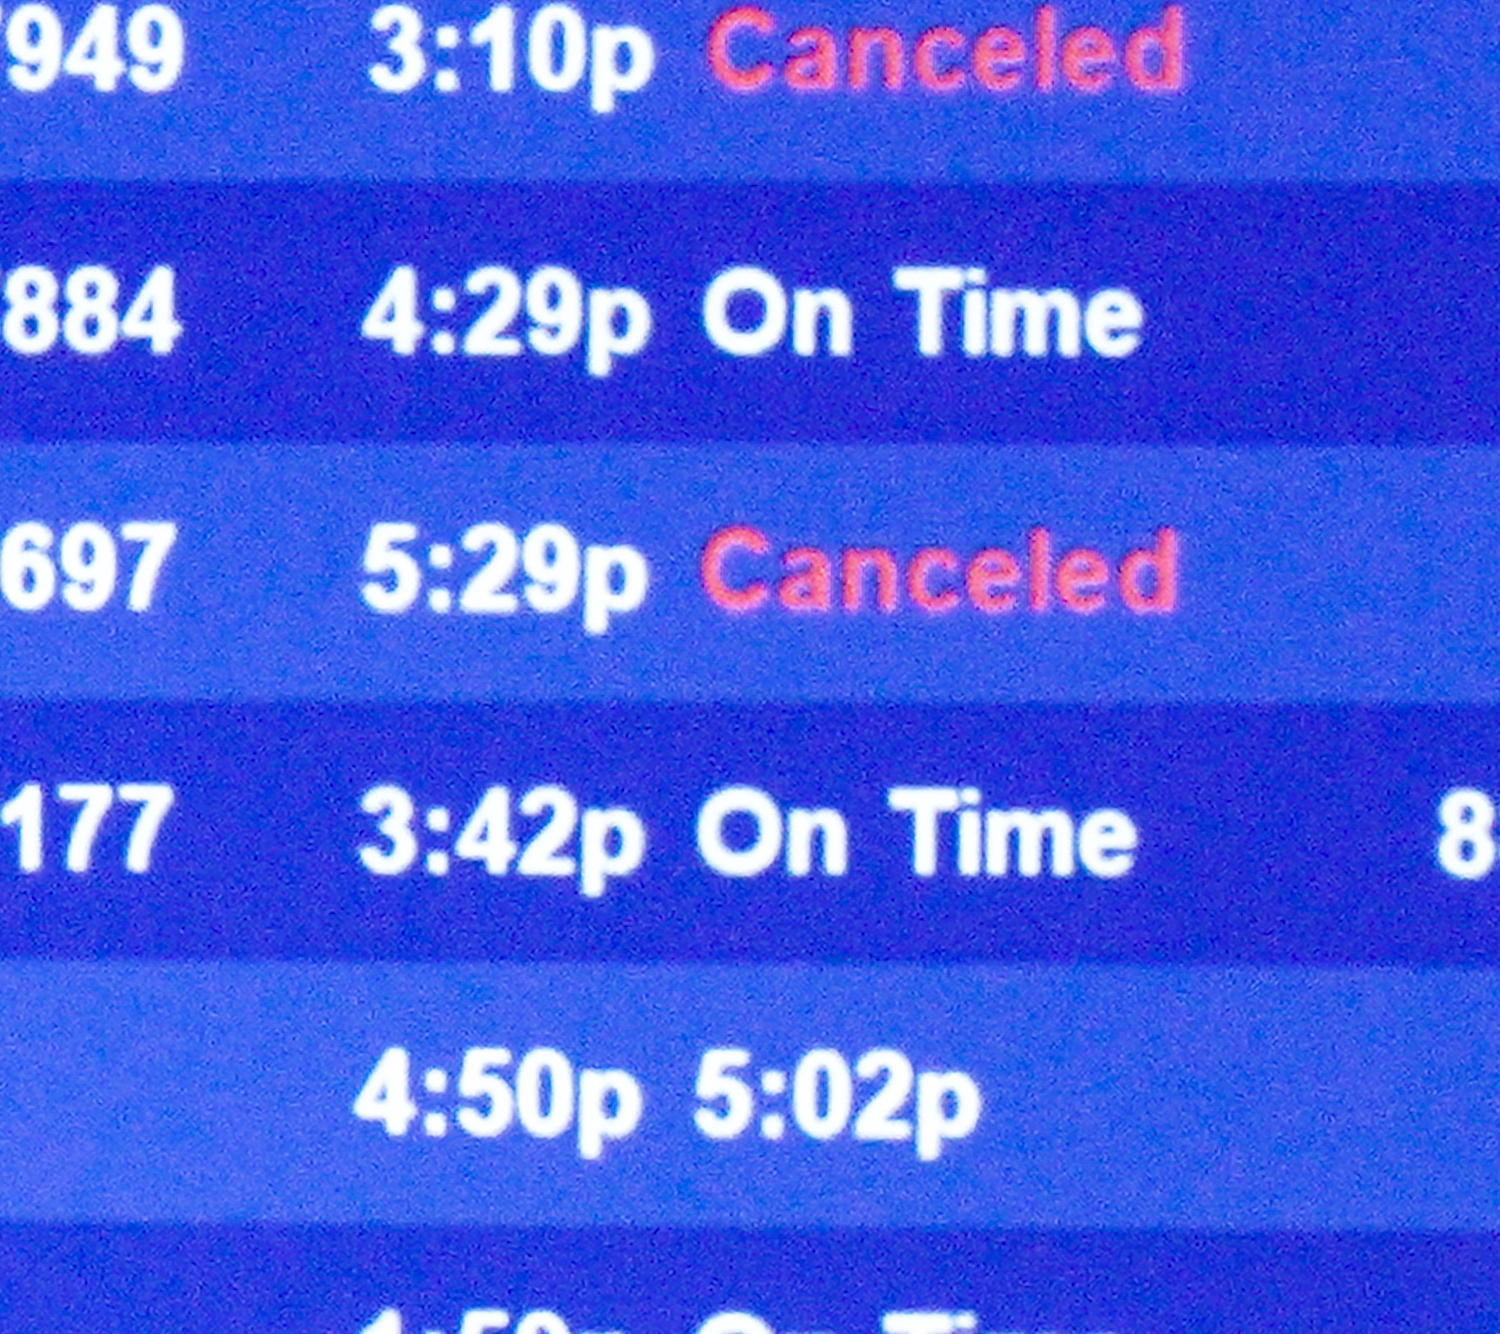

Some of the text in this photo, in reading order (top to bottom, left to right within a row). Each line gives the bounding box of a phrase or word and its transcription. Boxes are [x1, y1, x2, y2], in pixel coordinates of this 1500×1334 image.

[367, 1, 658, 116] 3:10p
[705, 3, 1188, 96] Canceled
[361, 264, 654, 379] 4:29p
[702, 265, 1145, 359] On Time
[360, 520, 652, 637] 5:29p
[699, 523, 1182, 618] Canceled
[358, 783, 648, 899] 3:42p
[696, 785, 1140, 880] On Time
[1437, 786, 1499, 881] 8
[351, 1044, 646, 1163] 4:50p
[692, 1045, 986, 1164] 5:02p
